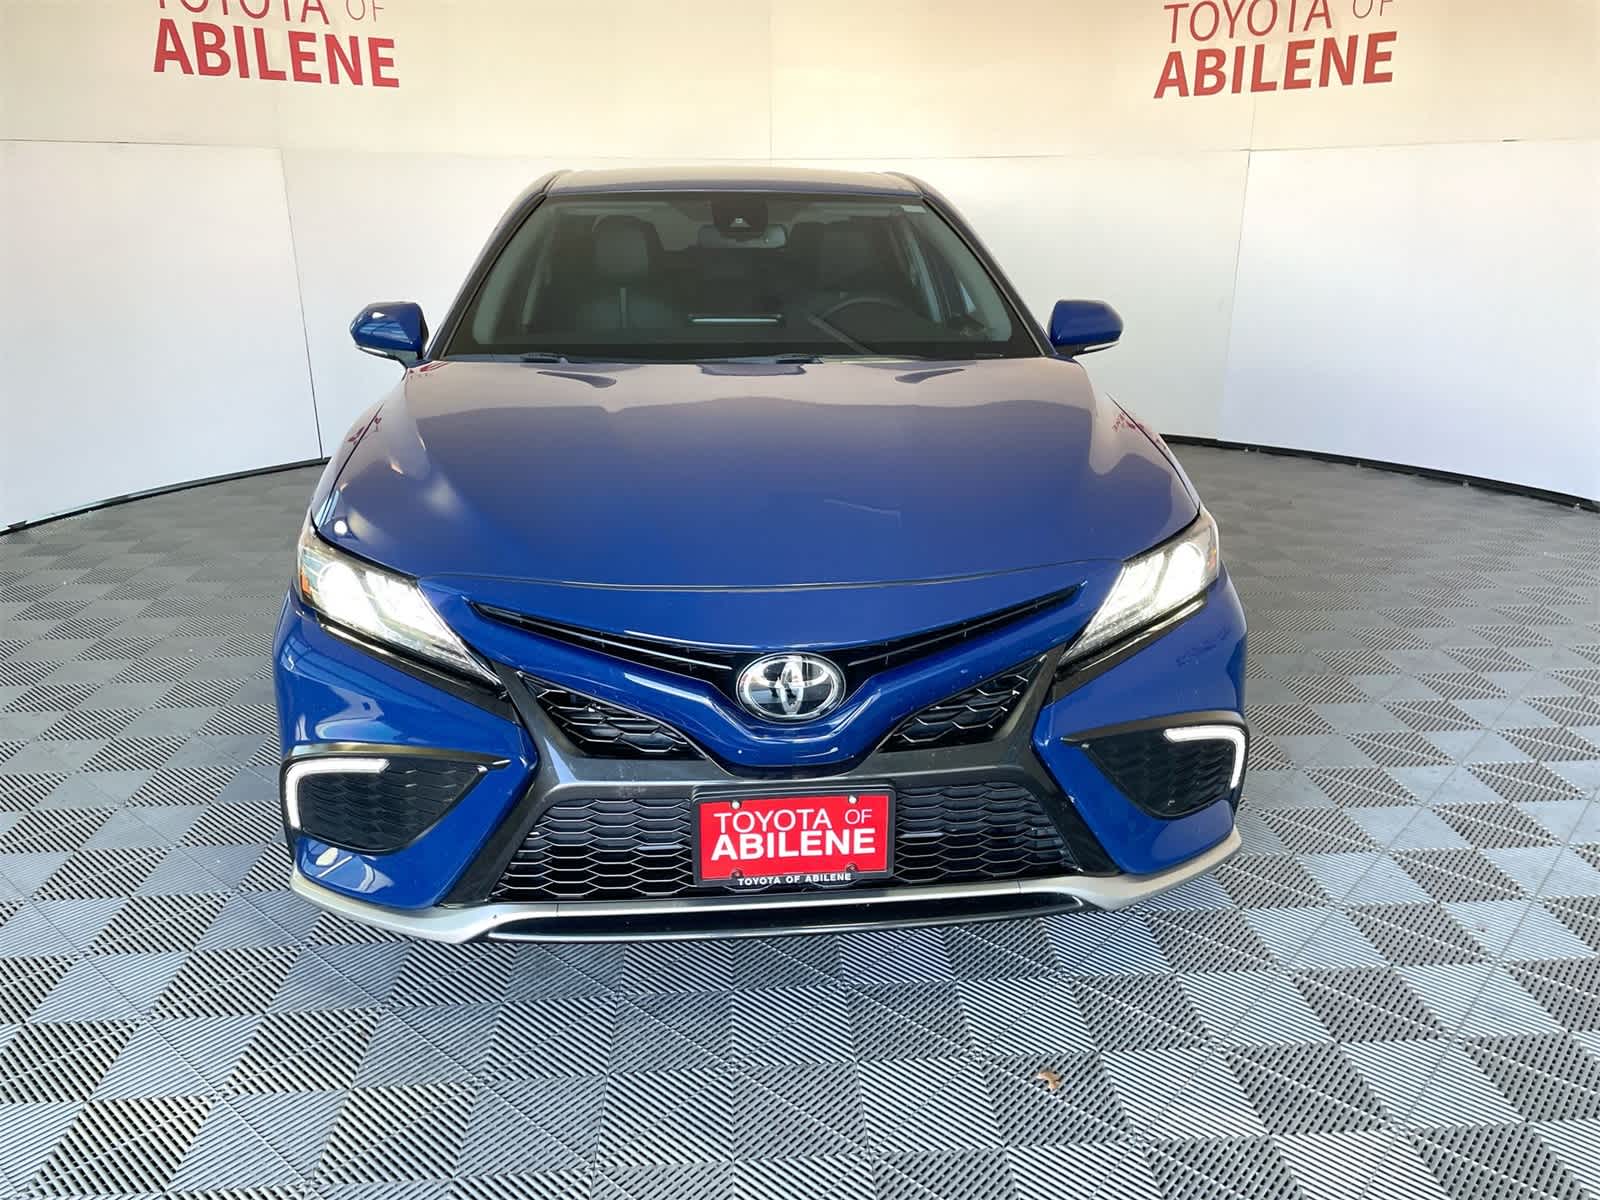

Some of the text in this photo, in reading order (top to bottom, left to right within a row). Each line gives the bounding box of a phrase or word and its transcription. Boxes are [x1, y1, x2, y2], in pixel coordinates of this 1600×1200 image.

[1163, 0, 1333, 43] TOYOTA
[153, 18, 400, 88] ABILENE
[1153, 31, 1398, 99] ABILENE
[713, 808, 873, 834] TOYOTA OF
[711, 828, 876, 861] ABILENE
[737, 872, 852, 886] TOYOTA OF ABILENE
